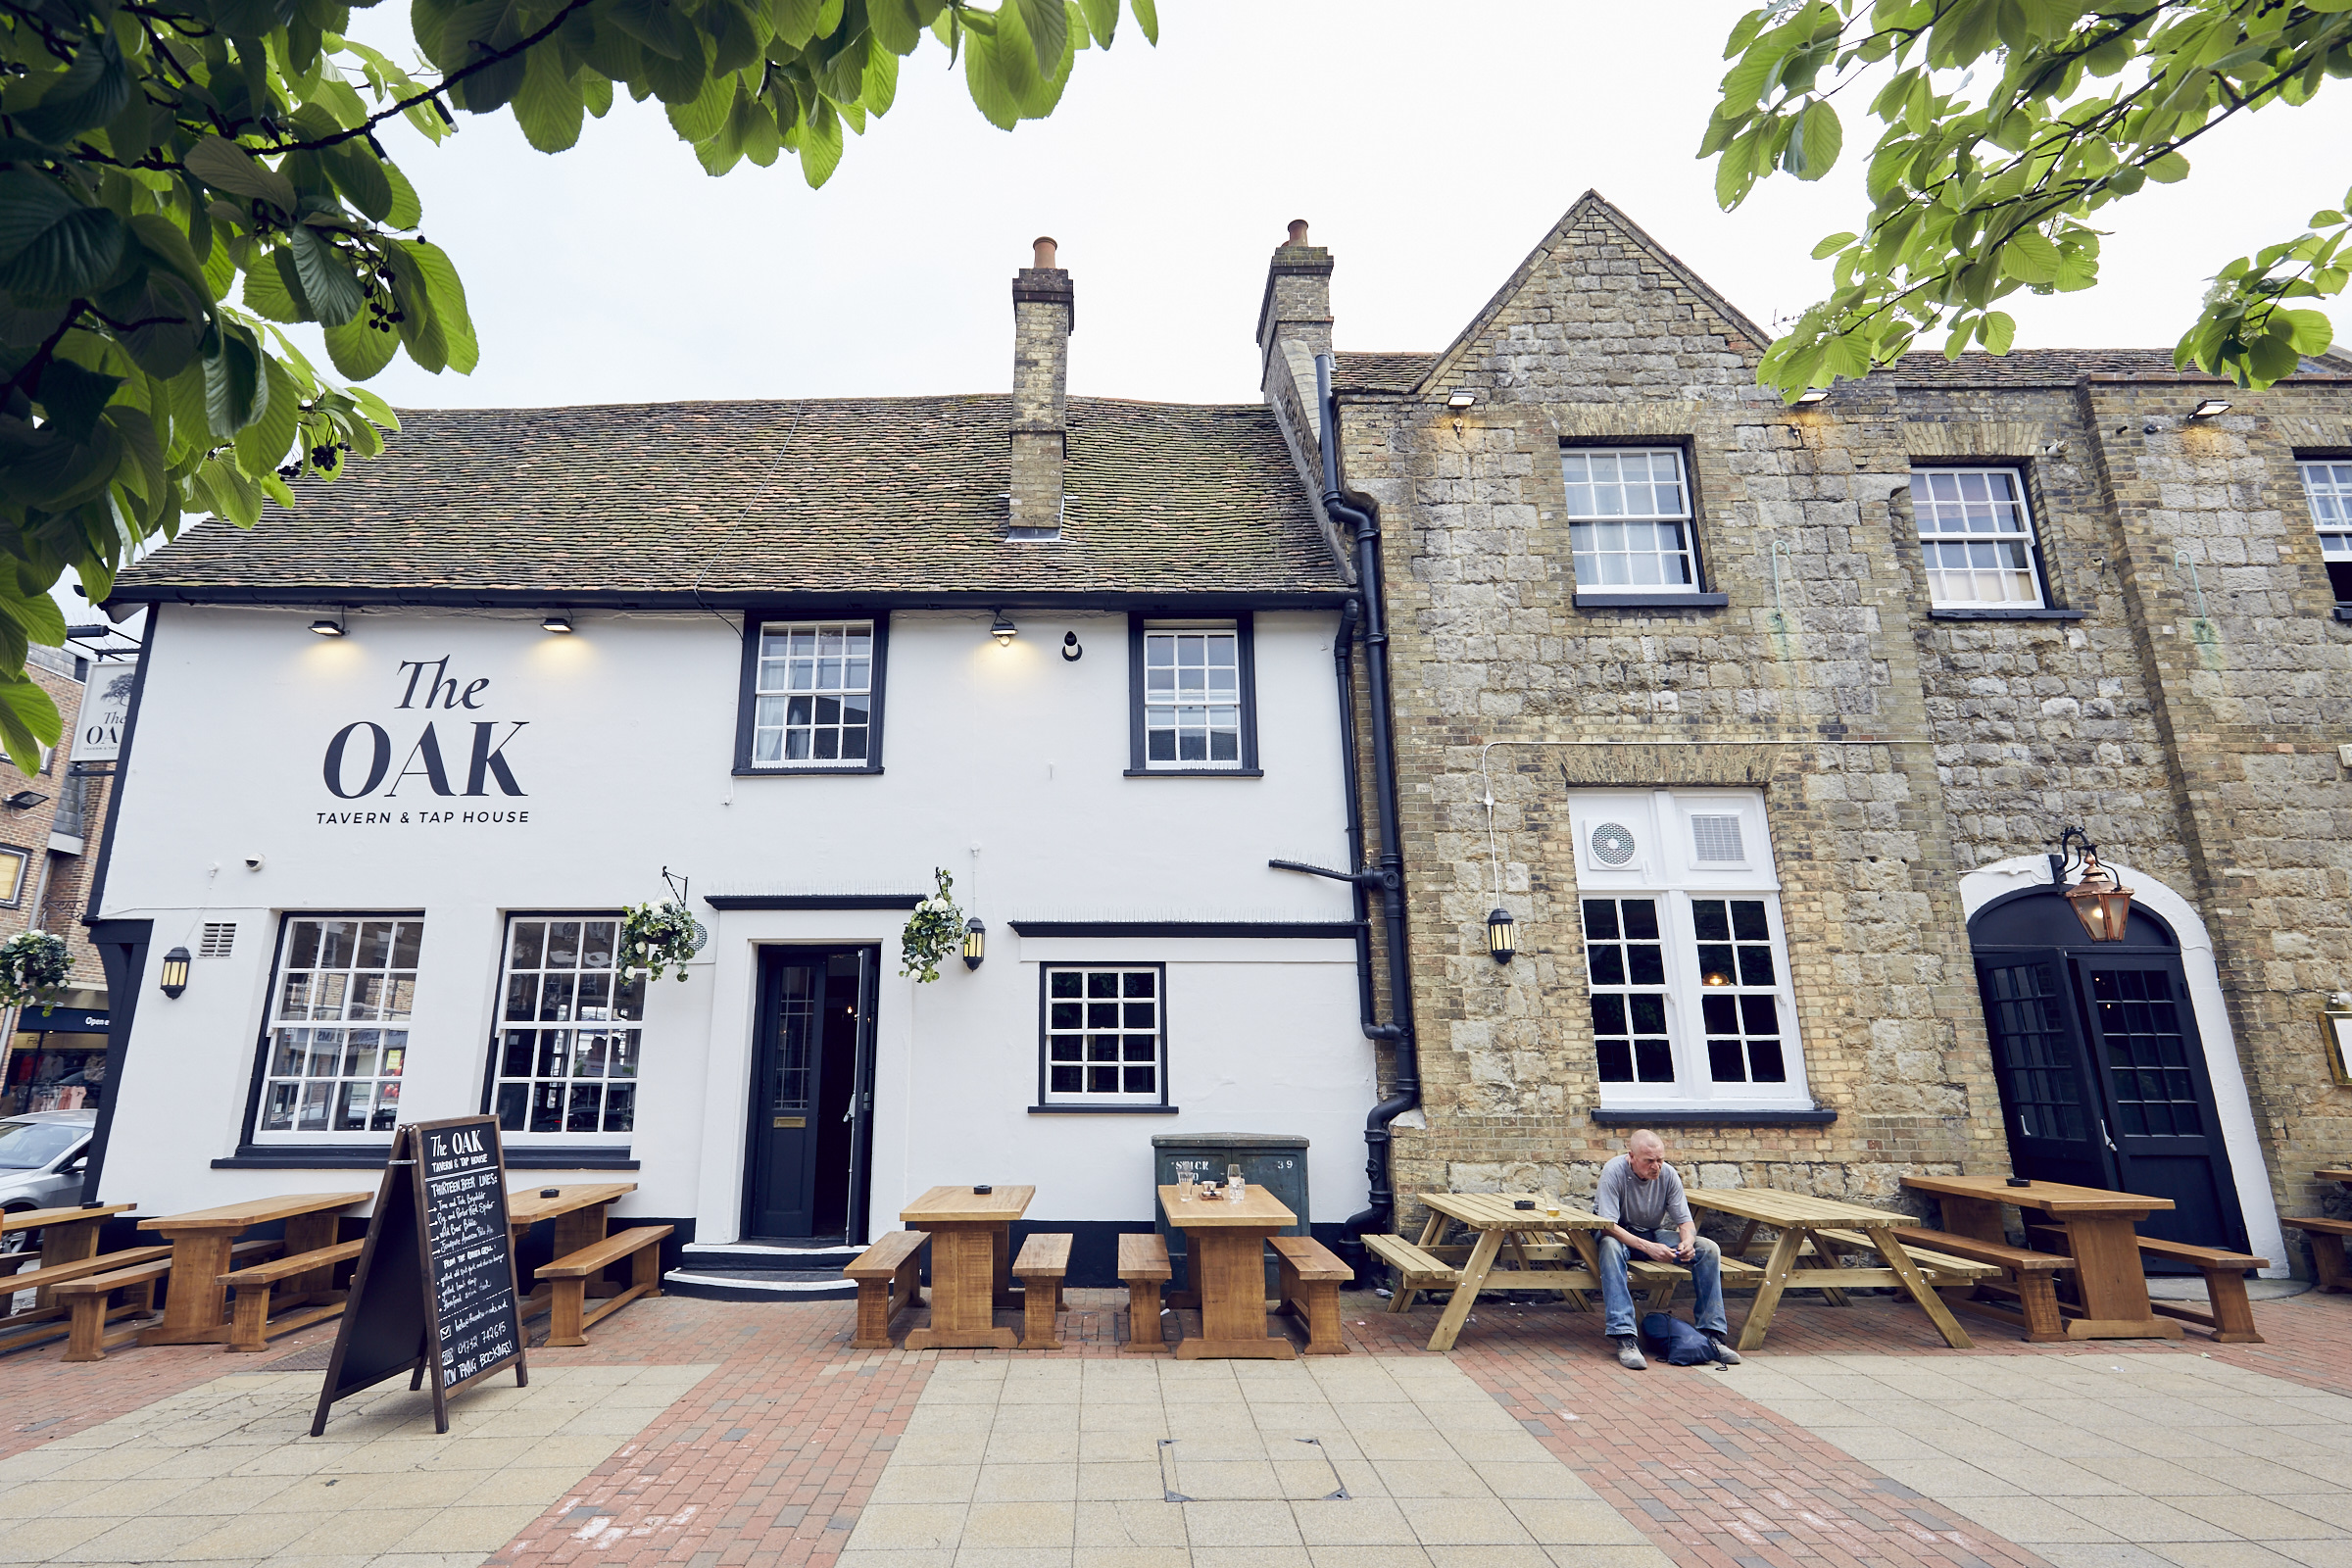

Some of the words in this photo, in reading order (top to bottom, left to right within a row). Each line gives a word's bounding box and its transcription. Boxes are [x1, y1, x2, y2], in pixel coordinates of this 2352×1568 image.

[394, 654, 490, 710] The
[104, 711, 125, 724] The
[86, 725, 118, 745] OA
[323, 720, 530, 800] OAK
[317, 812, 392, 824] TAVERN
[400, 811, 410, 823] &
[419, 811, 454, 823] TAP
[463, 811, 529, 823] HOUSE
[85, 1016, 105, 1027] Open
[430, 1134, 448, 1157] The
[452, 1130, 483, 1154] OAK
[431, 1159, 454, 1173] TAVERN
[454, 1158, 459, 1168] &
[460, 1156, 469, 1167] TAP
[470, 1153, 488, 1165] HOUSE
[431, 1179, 461, 1198] THIRTEEN
[461, 1176, 476, 1192] BEER
